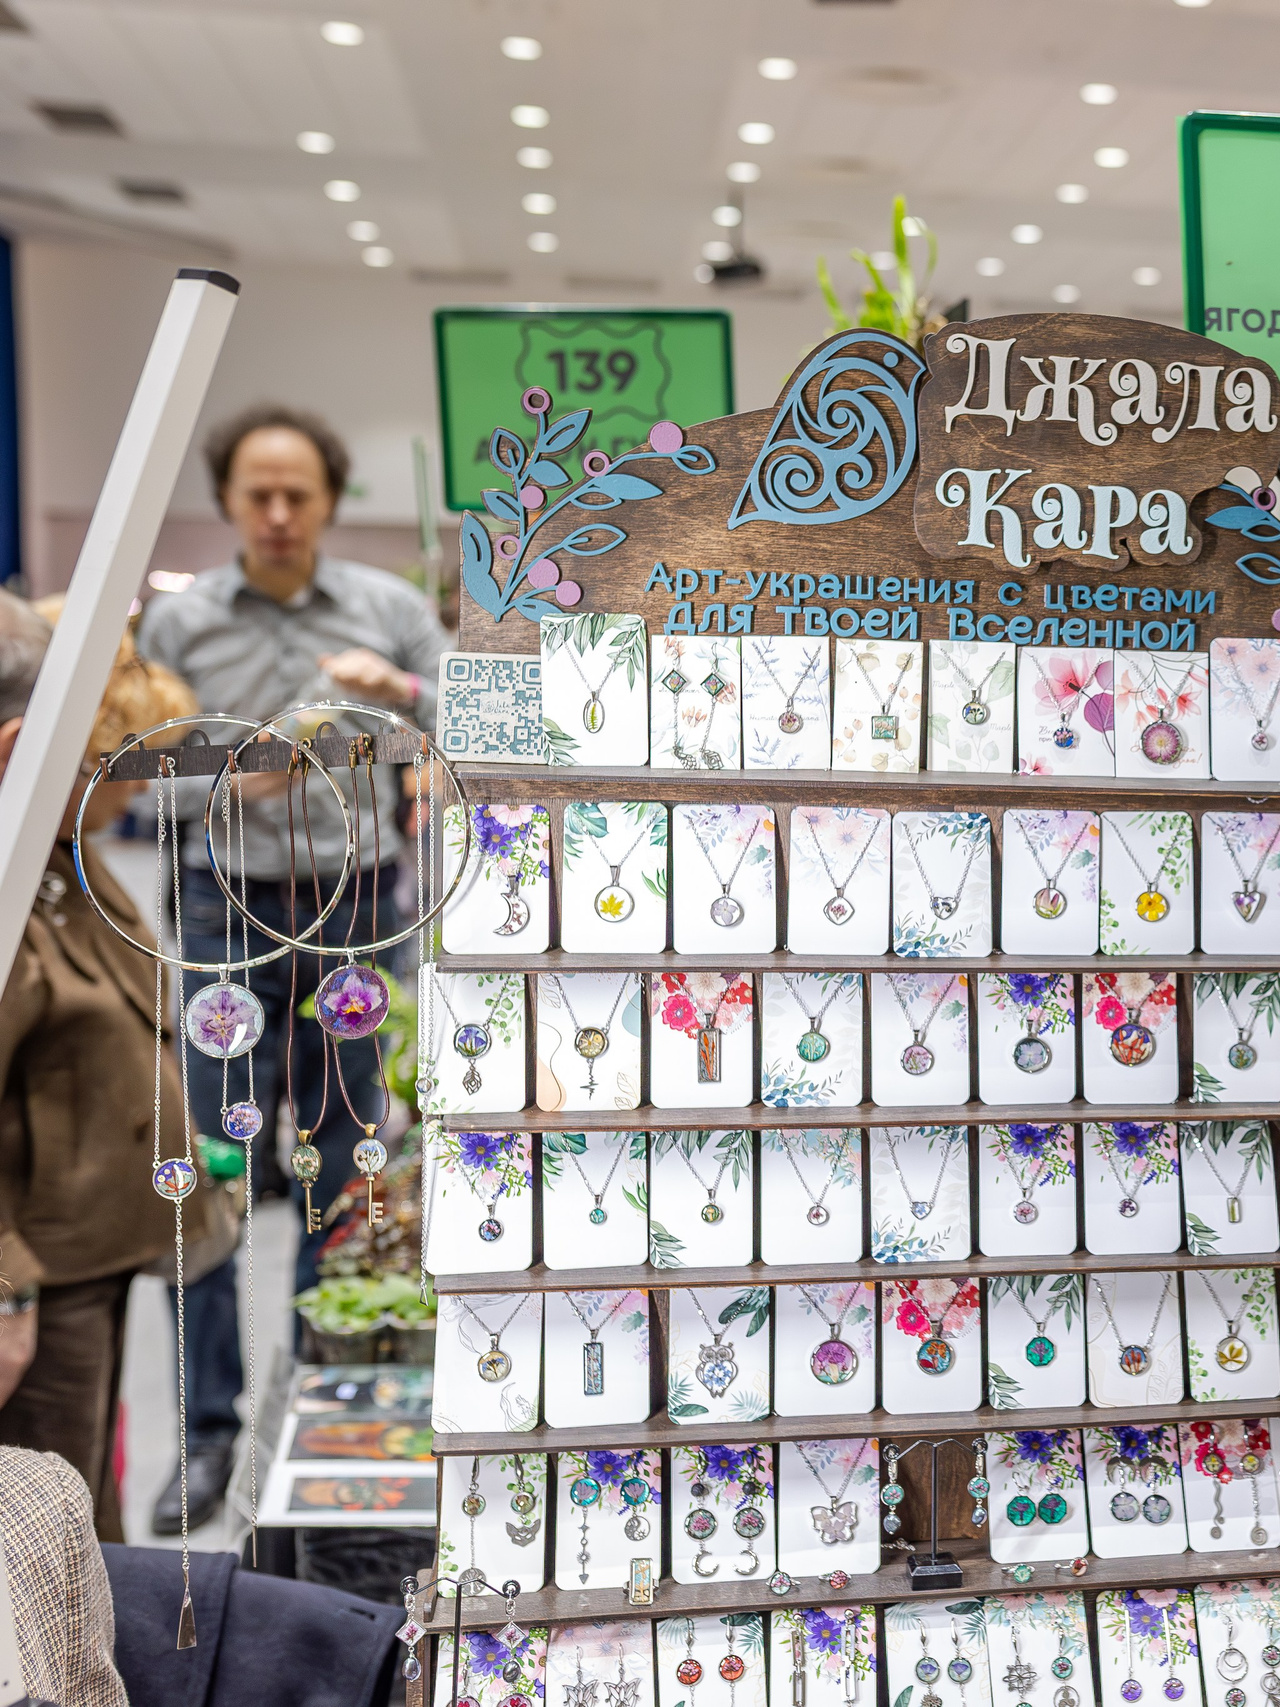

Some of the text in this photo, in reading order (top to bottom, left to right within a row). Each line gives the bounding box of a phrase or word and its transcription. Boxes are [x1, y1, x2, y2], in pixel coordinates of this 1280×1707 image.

[546, 347, 639, 394] 139
[944, 333, 1278, 446] Джала
[935, 467, 1194, 568] Кара
[644, 561, 1217, 616] Арт-украшения с цветами
[948, 606, 1197, 649] Вселенной
